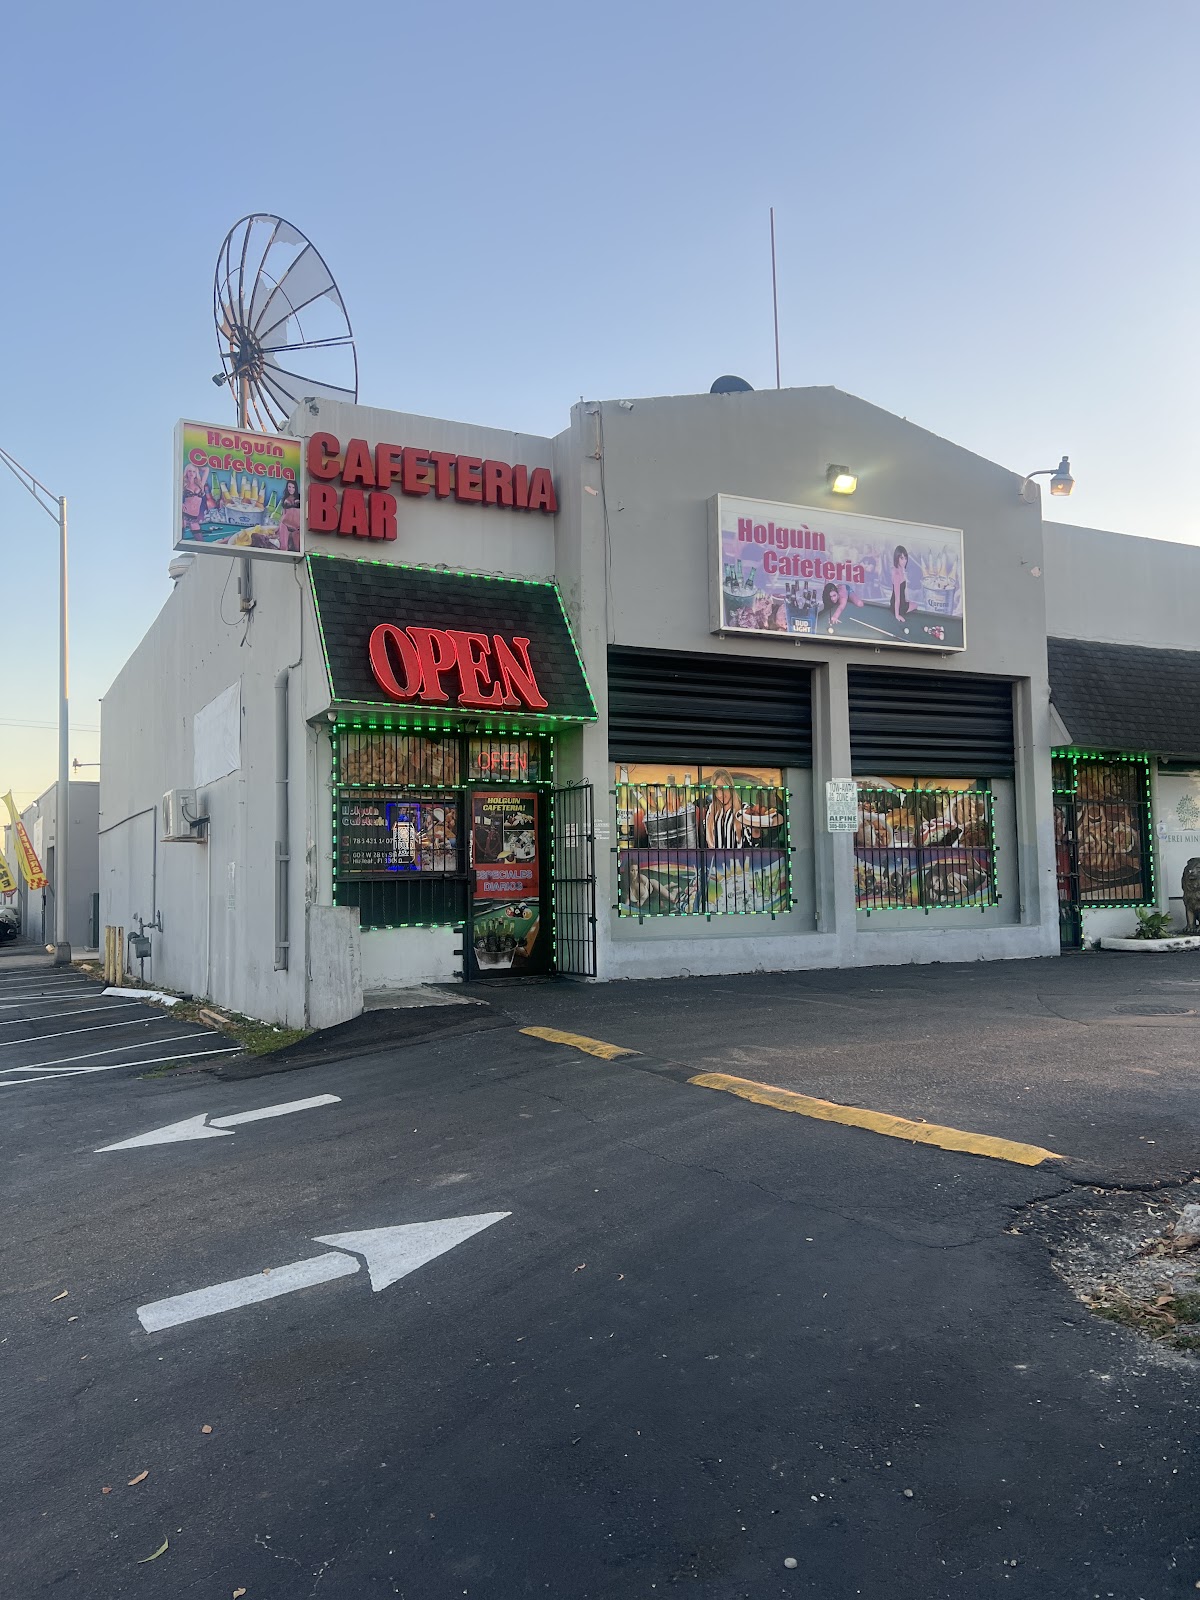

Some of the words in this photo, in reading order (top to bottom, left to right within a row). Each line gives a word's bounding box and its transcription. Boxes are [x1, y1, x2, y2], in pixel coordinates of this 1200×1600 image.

[189, 448, 295, 480] Cafeteria
[307, 432, 559, 512] CAFETERIA
[308, 482, 398, 541] BAR
[763, 550, 865, 584] Cafeteria
[793, 625, 811, 633] LIGHT
[369, 623, 549, 709] OPEN
[478, 752, 527, 771] OPEN
[483, 881, 523, 891] DIARIOS
